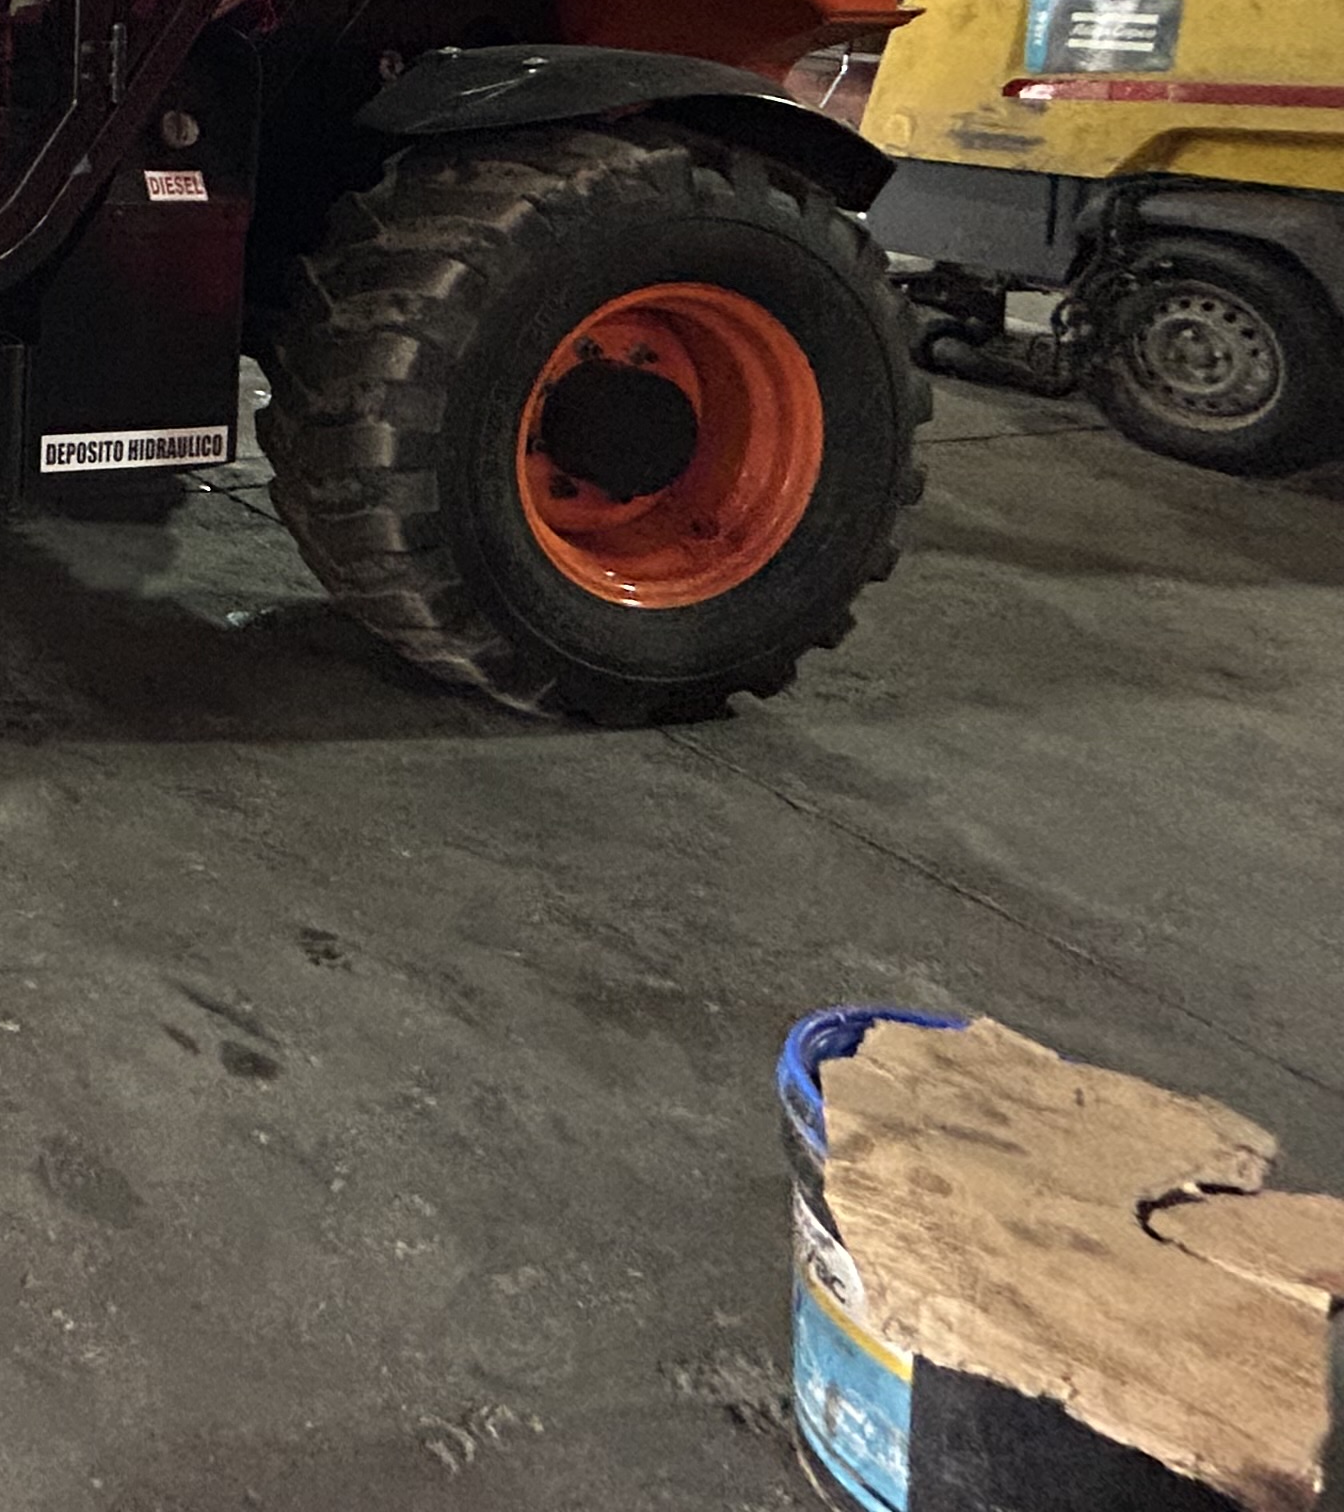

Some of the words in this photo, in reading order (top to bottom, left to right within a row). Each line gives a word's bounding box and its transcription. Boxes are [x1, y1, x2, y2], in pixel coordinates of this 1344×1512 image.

[148, 176, 204, 195] DIESEL
[45, 440, 124, 465] DEPOSITO
[128, 434, 223, 461] HIDRAULICO
